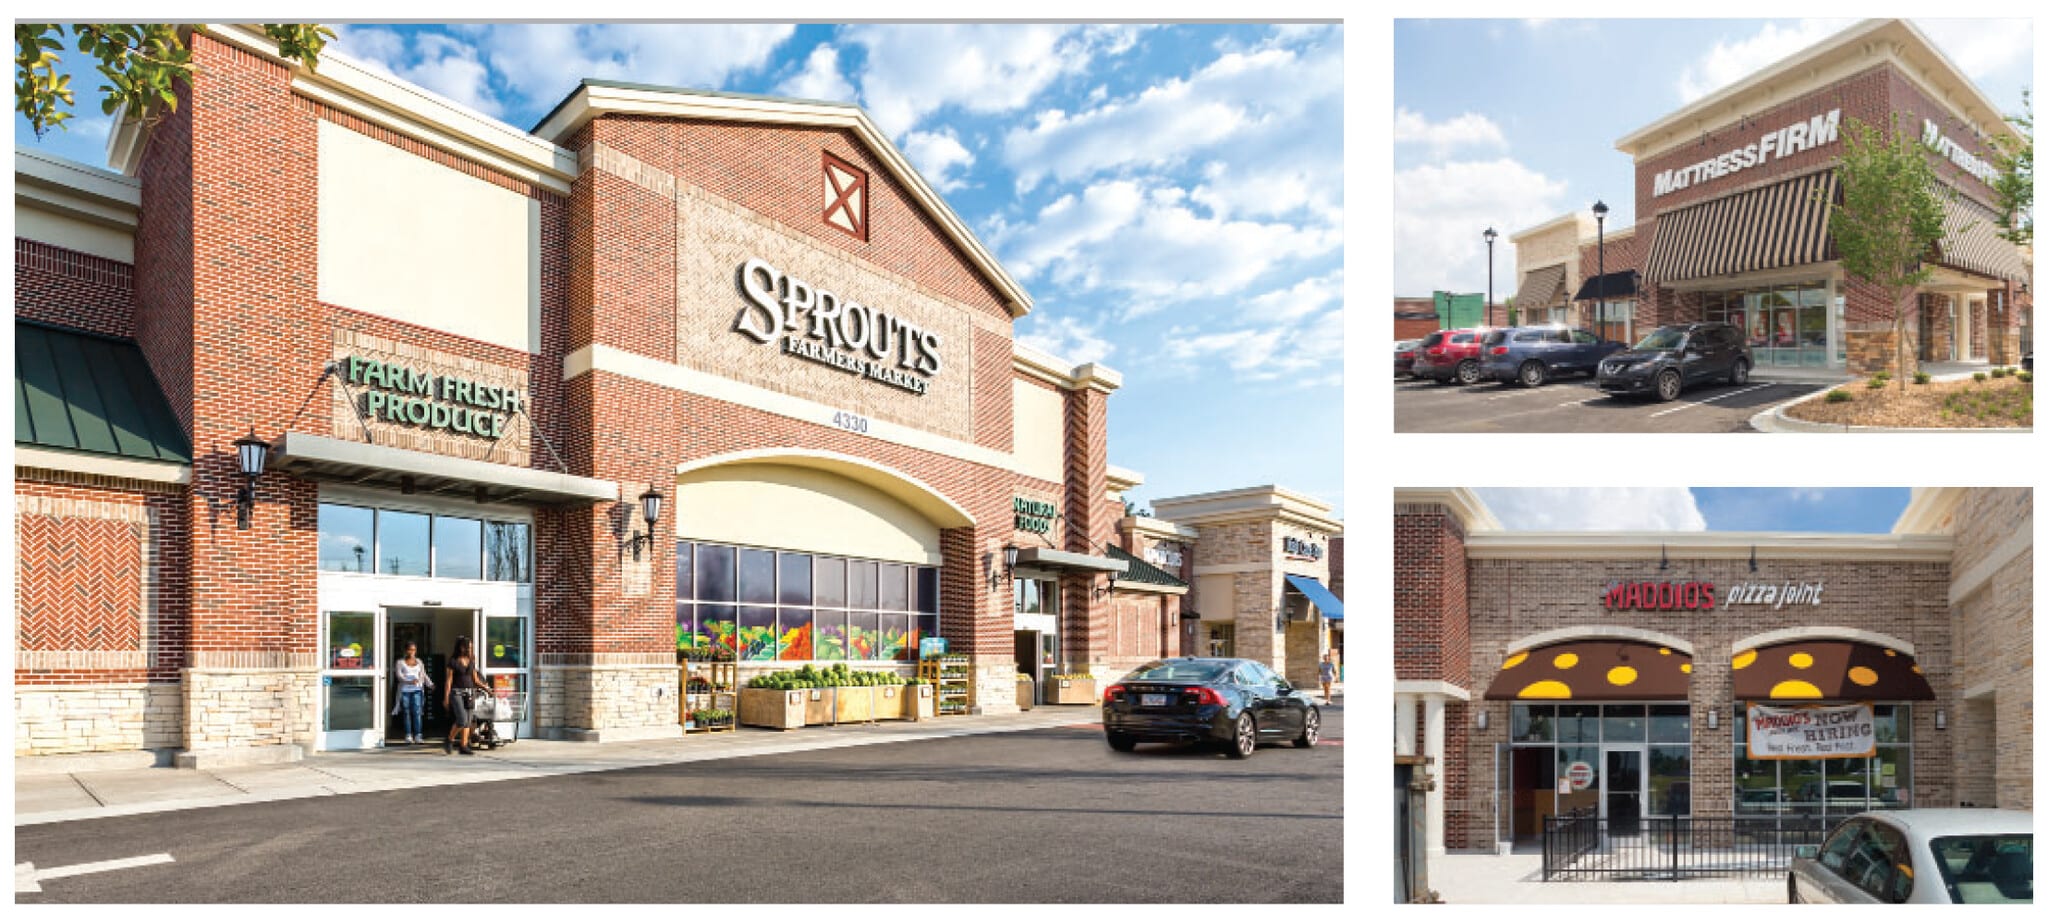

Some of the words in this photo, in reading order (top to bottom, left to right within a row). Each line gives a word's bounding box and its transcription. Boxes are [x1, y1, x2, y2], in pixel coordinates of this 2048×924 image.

[735, 257, 943, 376] SPROUTS
[350, 355, 433, 396] FARM
[442, 374, 521, 412] FRESH
[787, 337, 866, 374] FARMERS
[866, 361, 930, 395] MARKET
[367, 390, 505, 438] PRODUCE
[833, 411, 869, 434] 4330
[1722, 581, 1778, 610] pizza
[1774, 579, 1824, 610] joint
[1804, 723, 1872, 741] HIRING
[1814, 711, 1858, 726] NOW
